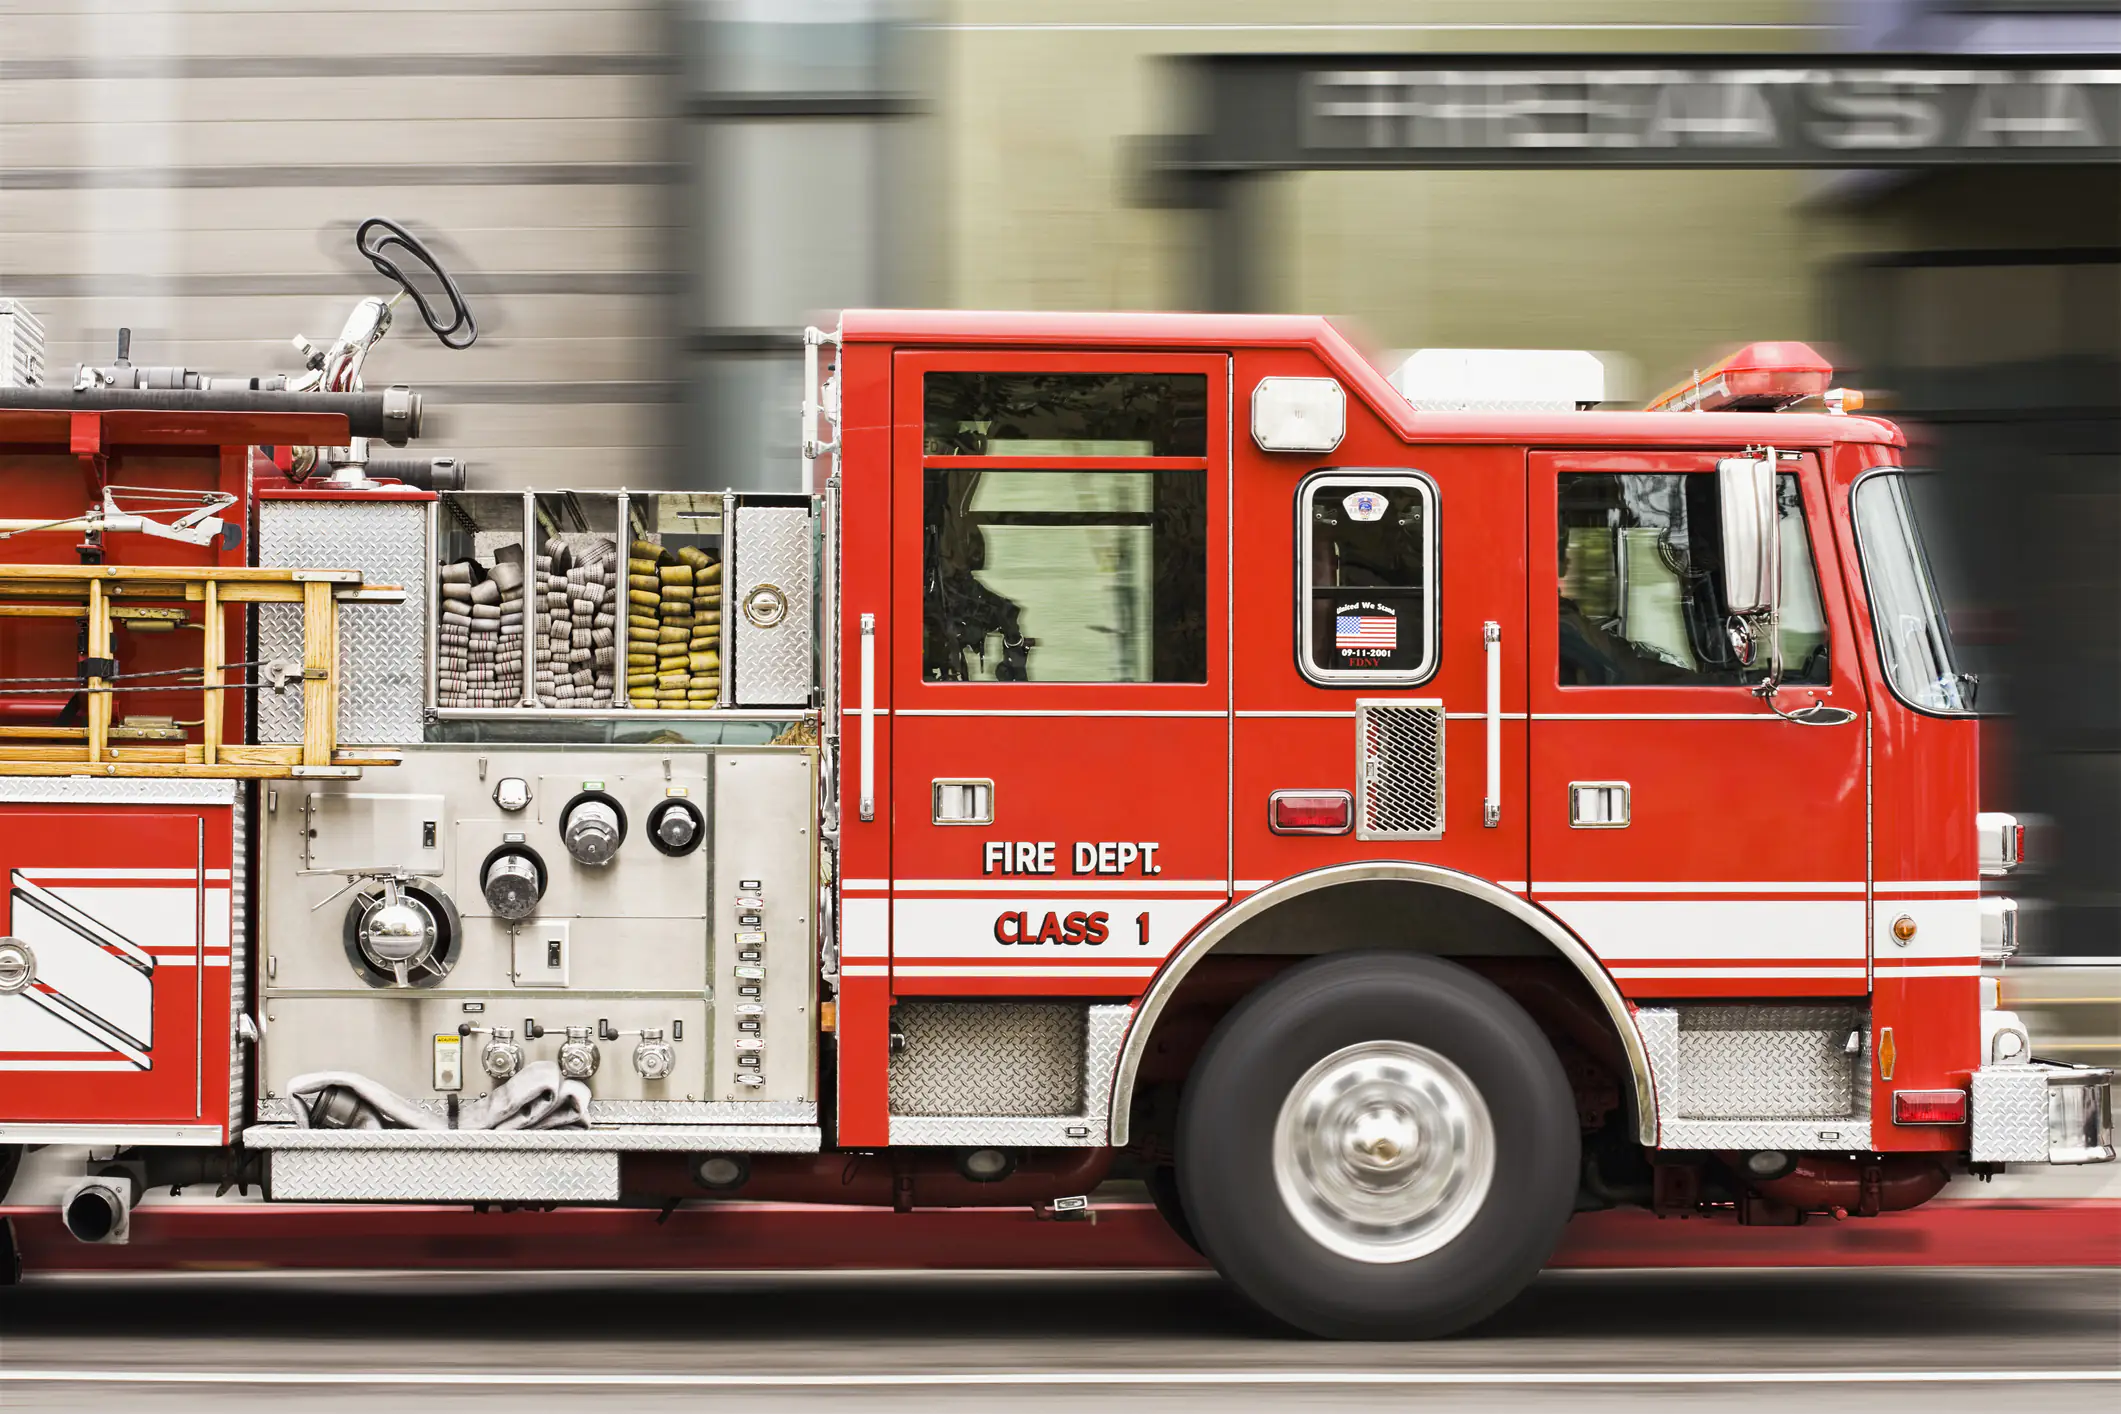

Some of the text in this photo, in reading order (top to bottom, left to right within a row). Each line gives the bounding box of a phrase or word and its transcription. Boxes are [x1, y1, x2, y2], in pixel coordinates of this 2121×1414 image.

[1336, 601, 1395, 615] United We Stand
[1341, 648, 1391, 658] 09-11-2001
[1349, 657, 1381, 667] FDNY
[983, 841, 1161, 876] FIRE DEPT.
[994, 911, 1150, 946] CLASS 1
